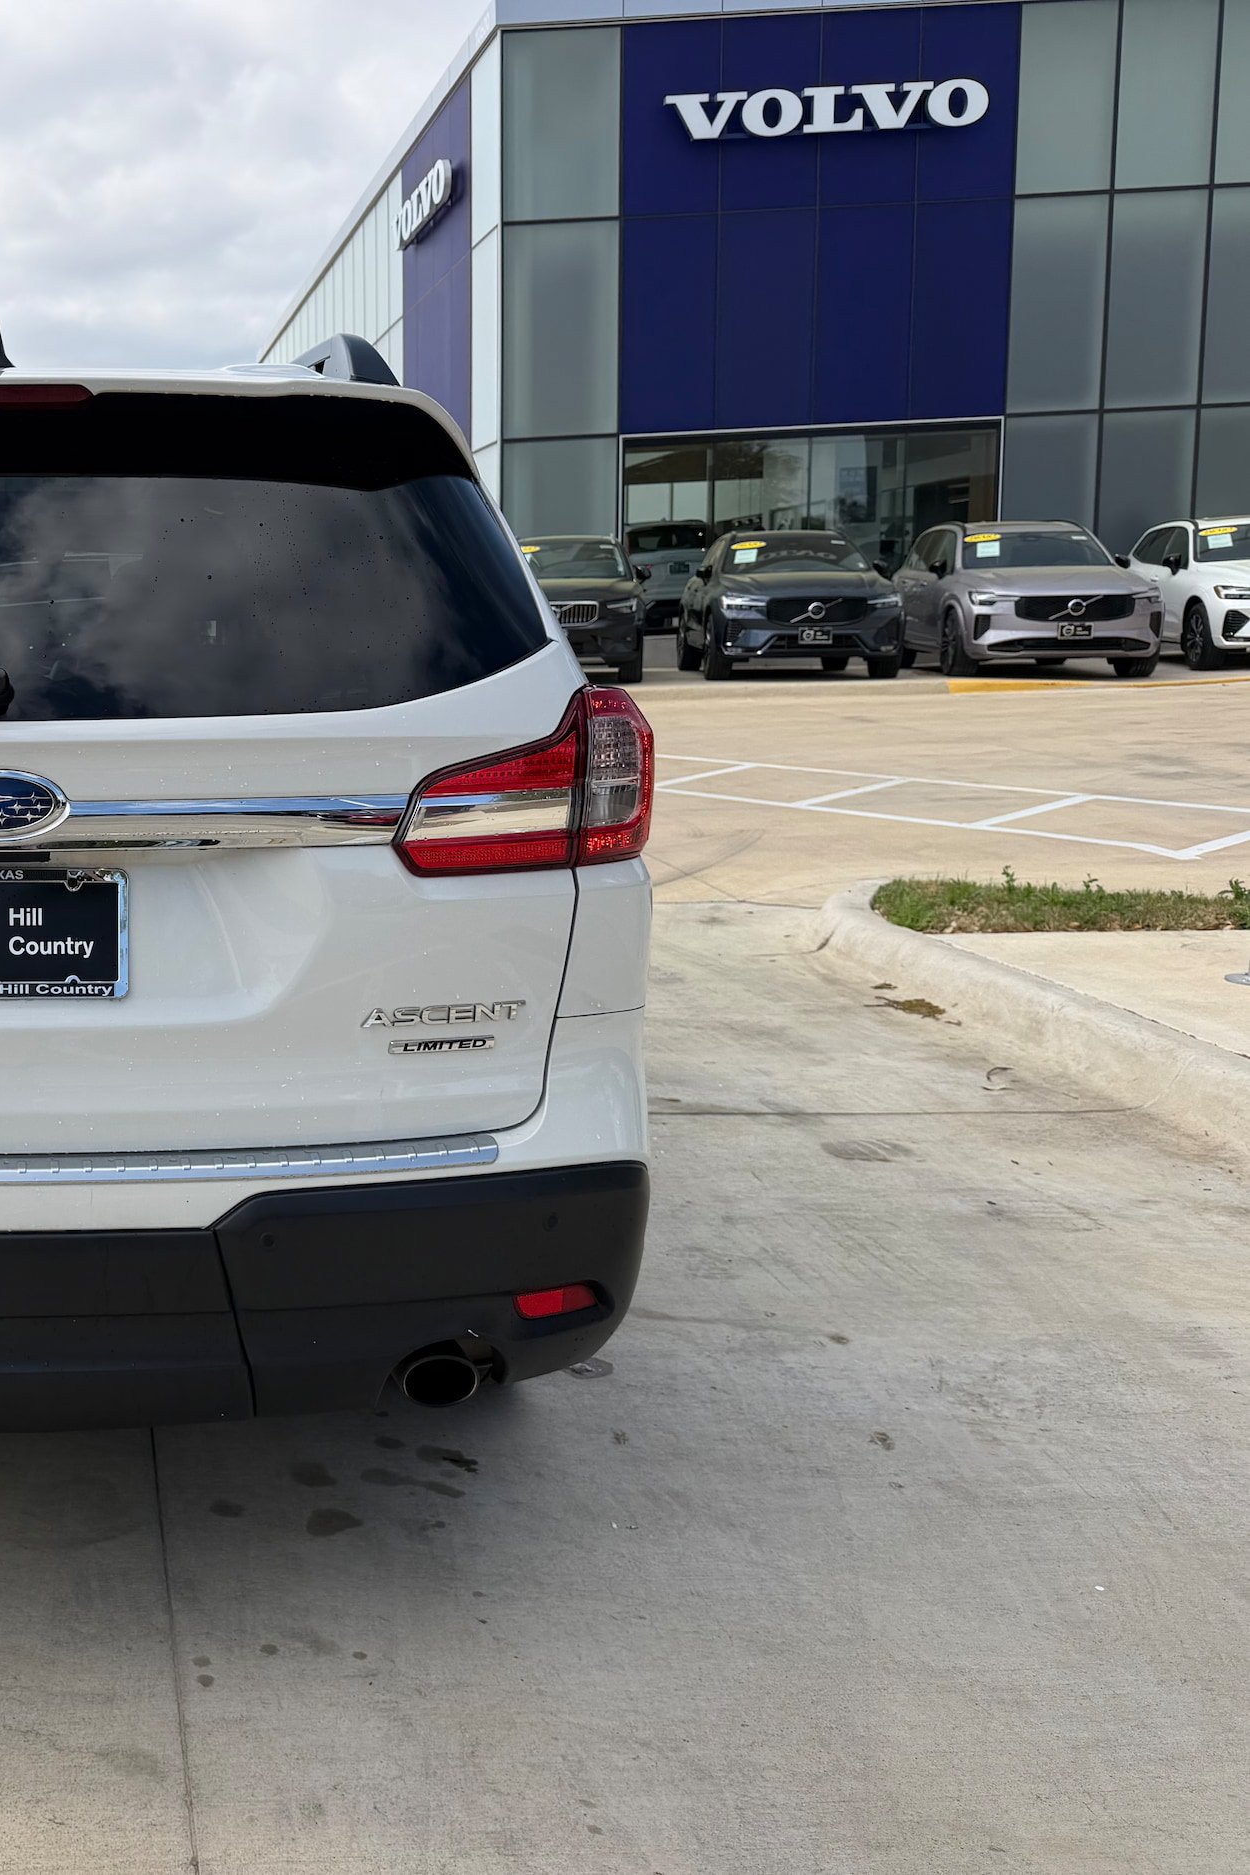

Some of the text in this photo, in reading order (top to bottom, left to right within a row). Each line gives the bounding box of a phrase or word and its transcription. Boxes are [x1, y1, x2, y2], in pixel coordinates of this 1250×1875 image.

[663, 78, 989, 141] VOLVO
[392, 159, 452, 251] VOLVO
[8, 907, 43, 927] Hill
[8, 936, 95, 959] Country
[0, 983, 30, 995] Hill
[35, 983, 113, 997] Country
[360, 1000, 527, 1029] ASCENT
[402, 1038, 487, 1052] LIMITED
